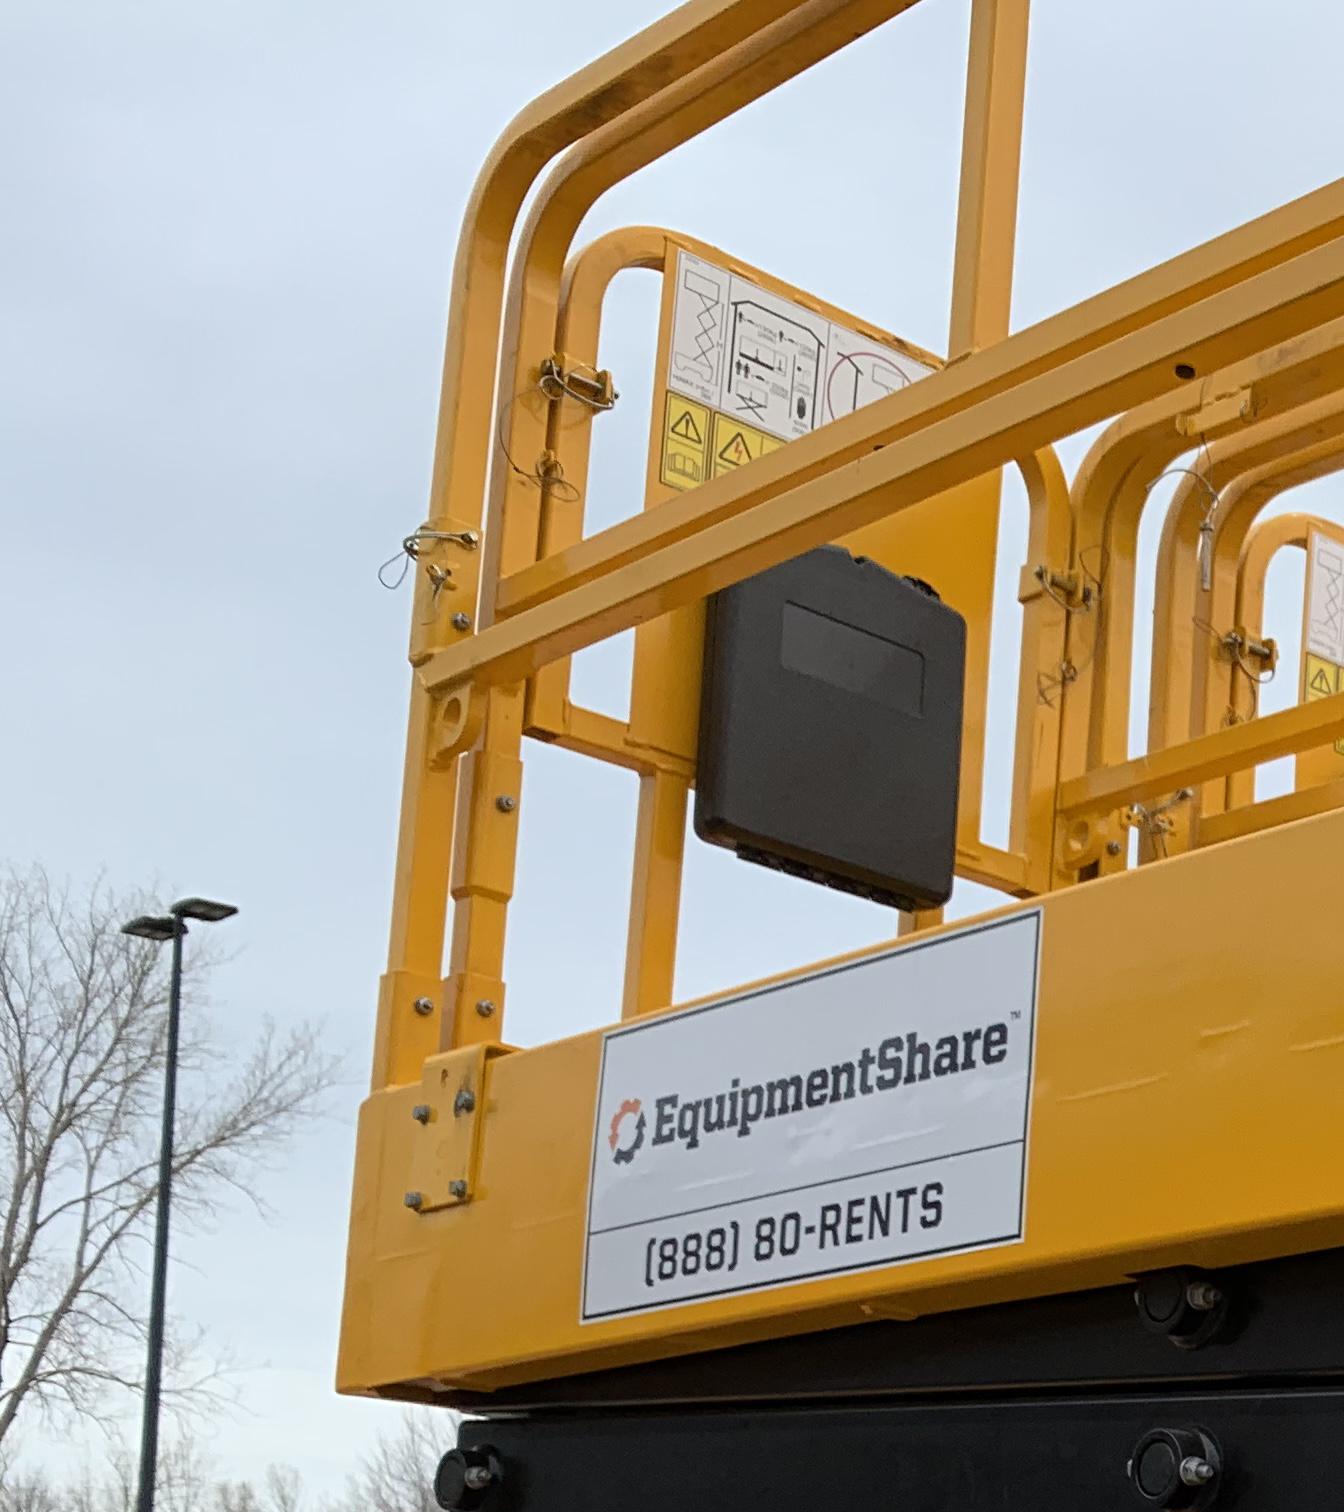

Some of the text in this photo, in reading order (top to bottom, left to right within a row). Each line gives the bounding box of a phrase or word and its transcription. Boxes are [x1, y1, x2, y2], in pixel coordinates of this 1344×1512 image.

[652, 1022, 1008, 1150] EquipmentShare
[645, 1182, 945, 1287] (888) 80-RENTS
